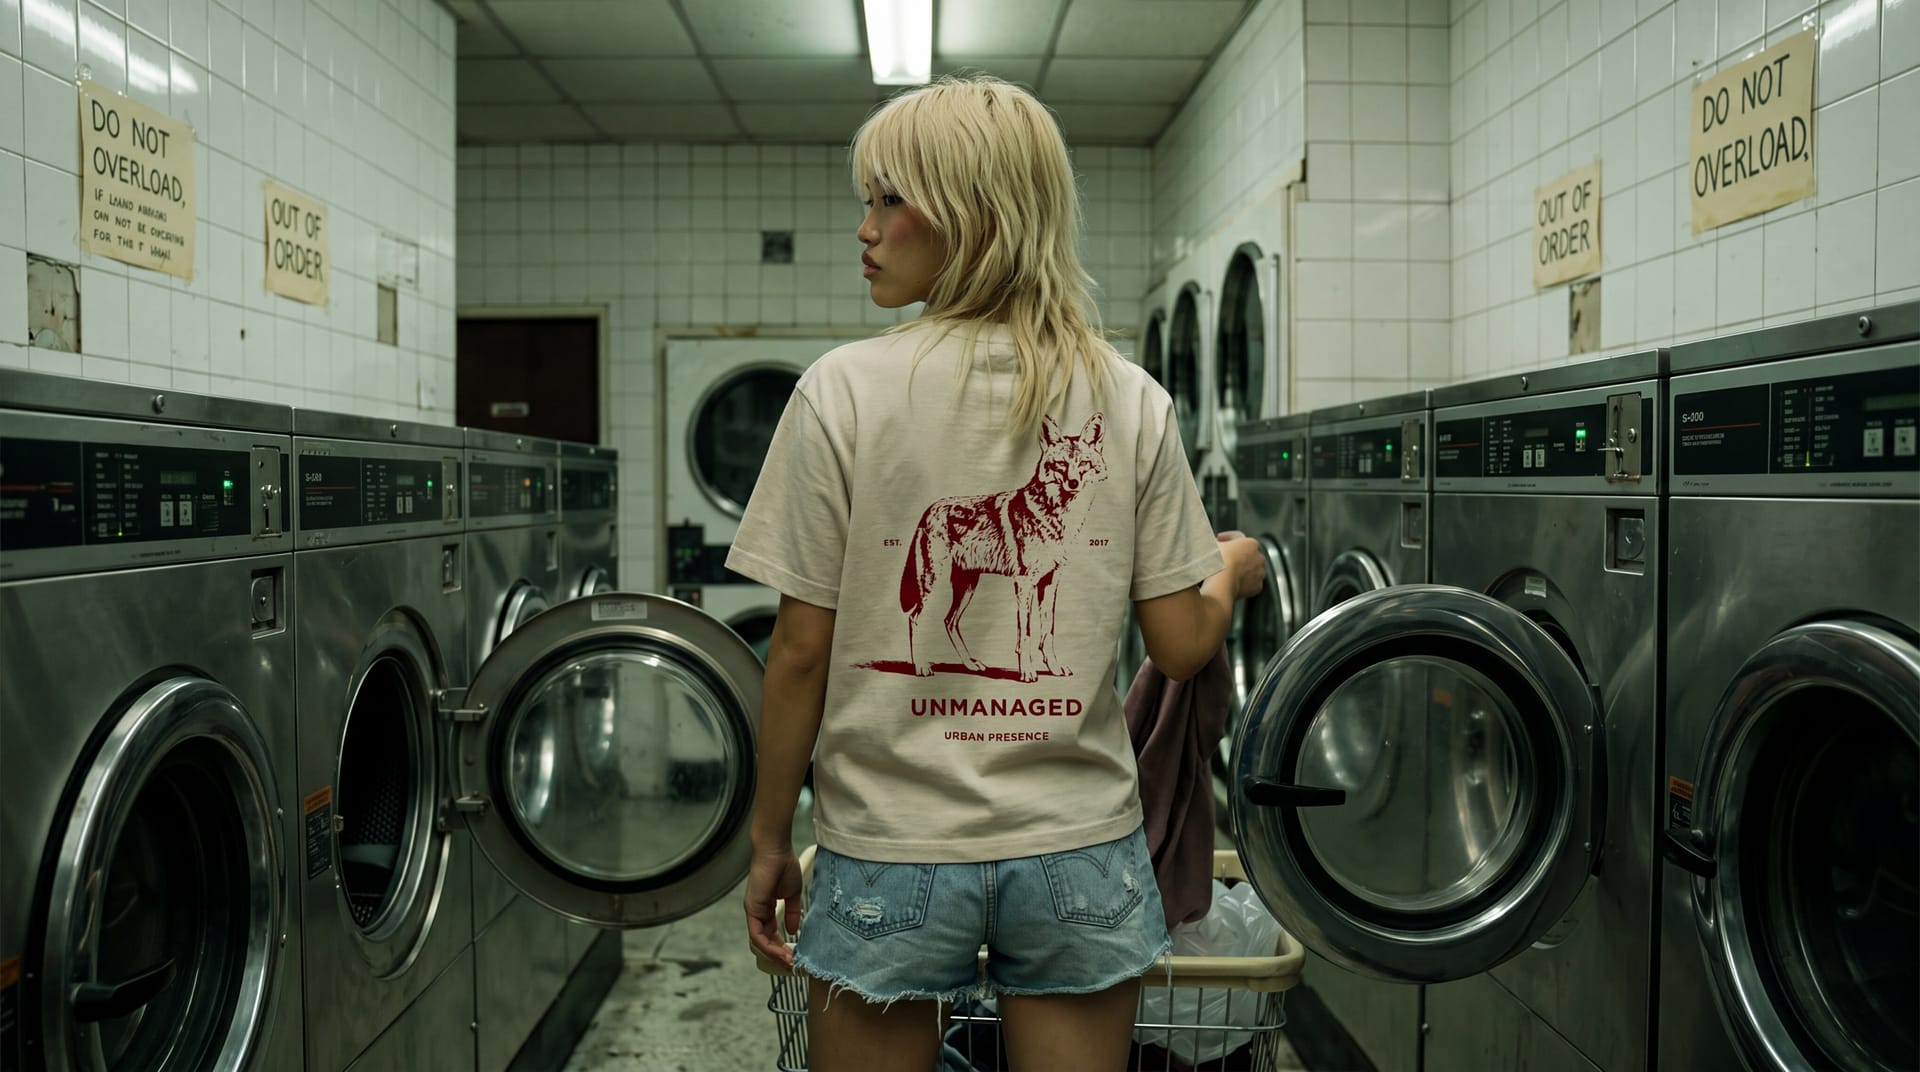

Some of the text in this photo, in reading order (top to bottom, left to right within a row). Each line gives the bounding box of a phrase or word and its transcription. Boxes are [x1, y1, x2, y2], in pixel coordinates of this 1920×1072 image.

[1702, 54, 1791, 133] DO NOT
[91, 99, 170, 159] DO NOT
[271, 198, 322, 241] OUT OF
[1538, 179, 1592, 227] OUT OF
[93, 228, 111, 243] FOR
[1539, 219, 1590, 265] ORDER
[274, 238, 324, 284] ORDER
[884, 539, 903, 547] EST.
[1089, 539, 1109, 547] 2017
[911, 698, 1083, 717] UNMANAGED
[944, 731, 1050, 743] URBAN PRESENCE
